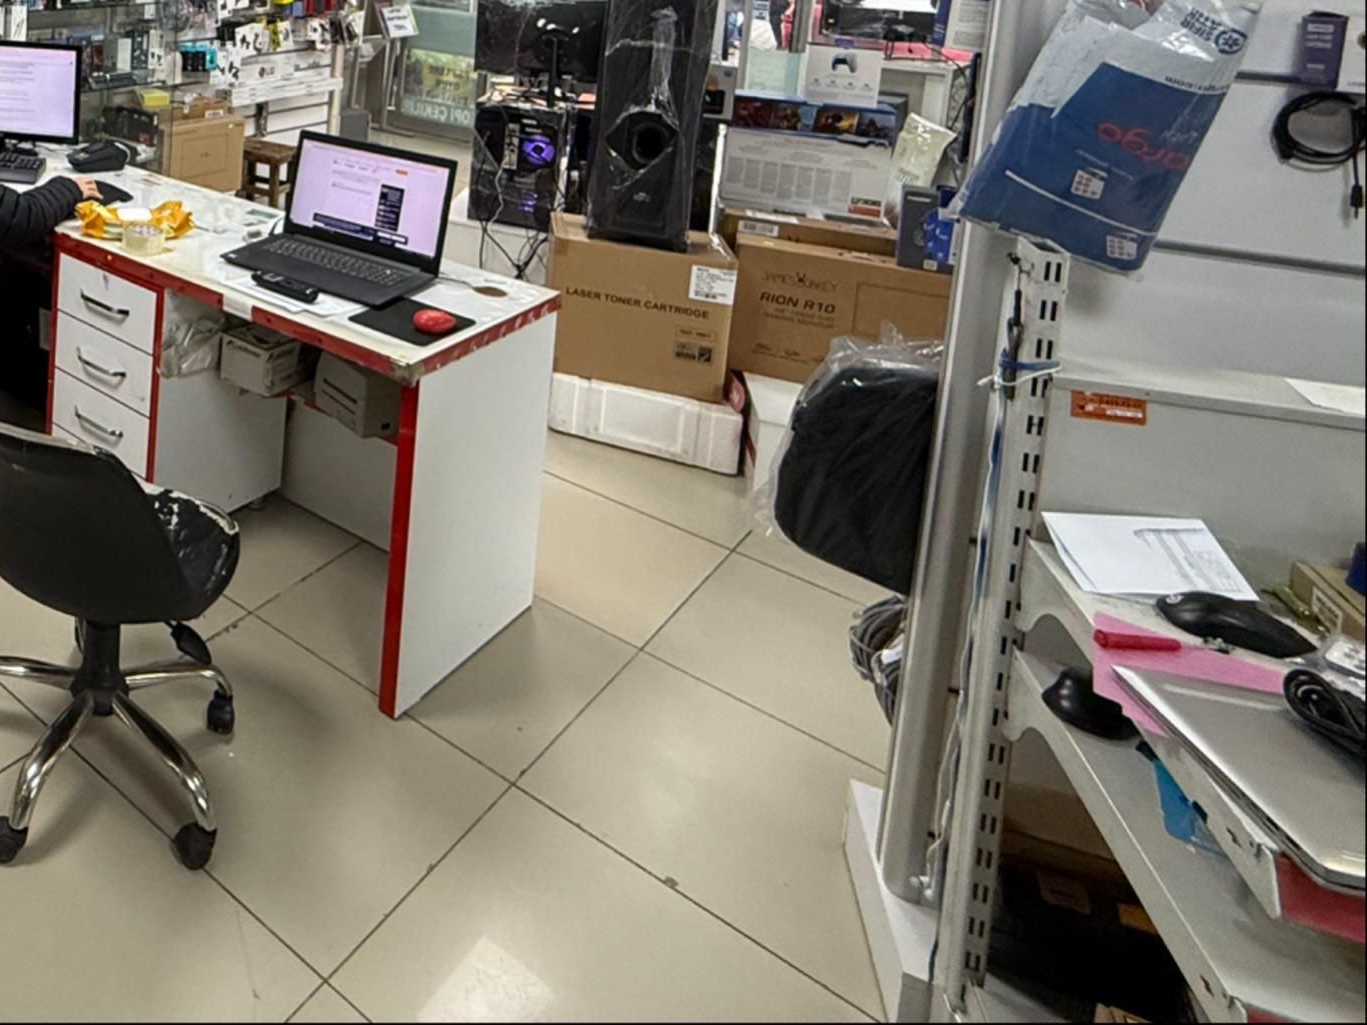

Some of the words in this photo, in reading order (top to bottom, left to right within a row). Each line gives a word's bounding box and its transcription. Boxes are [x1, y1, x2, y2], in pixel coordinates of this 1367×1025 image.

[565, 285, 602, 302] LASER
[604, 293, 642, 308] TONER
[643, 300, 710, 319] CARTRIDGE
[760, 291, 799, 308] RION
[804, 300, 837, 314] R10
